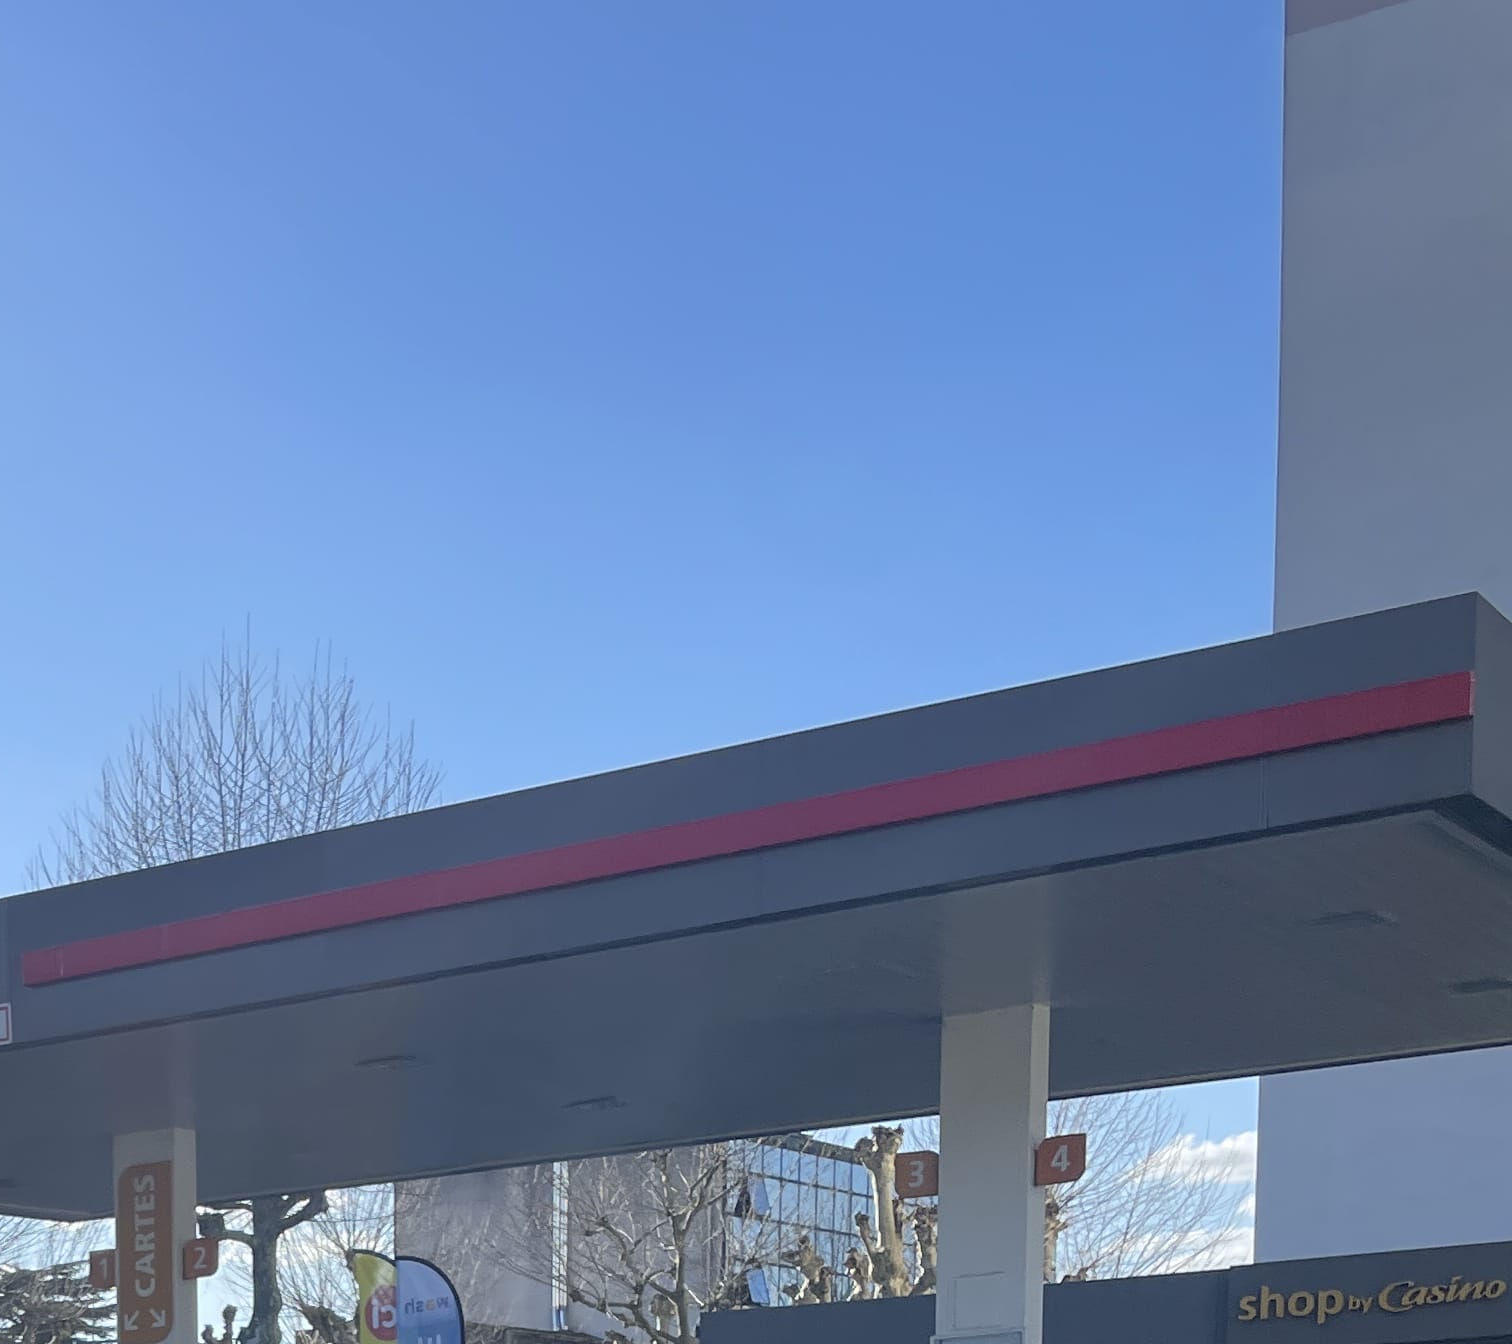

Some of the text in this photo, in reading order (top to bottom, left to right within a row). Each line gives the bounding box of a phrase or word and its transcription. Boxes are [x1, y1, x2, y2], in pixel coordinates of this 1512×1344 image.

[1050, 1144, 1071, 1173] 4
[908, 1160, 925, 1188] 3
[134, 1173, 156, 1298] CARTES
[99, 1258, 109, 1281] 1
[193, 1246, 208, 1270] 2
[1237, 1275, 1508, 1326] shop by Casino
